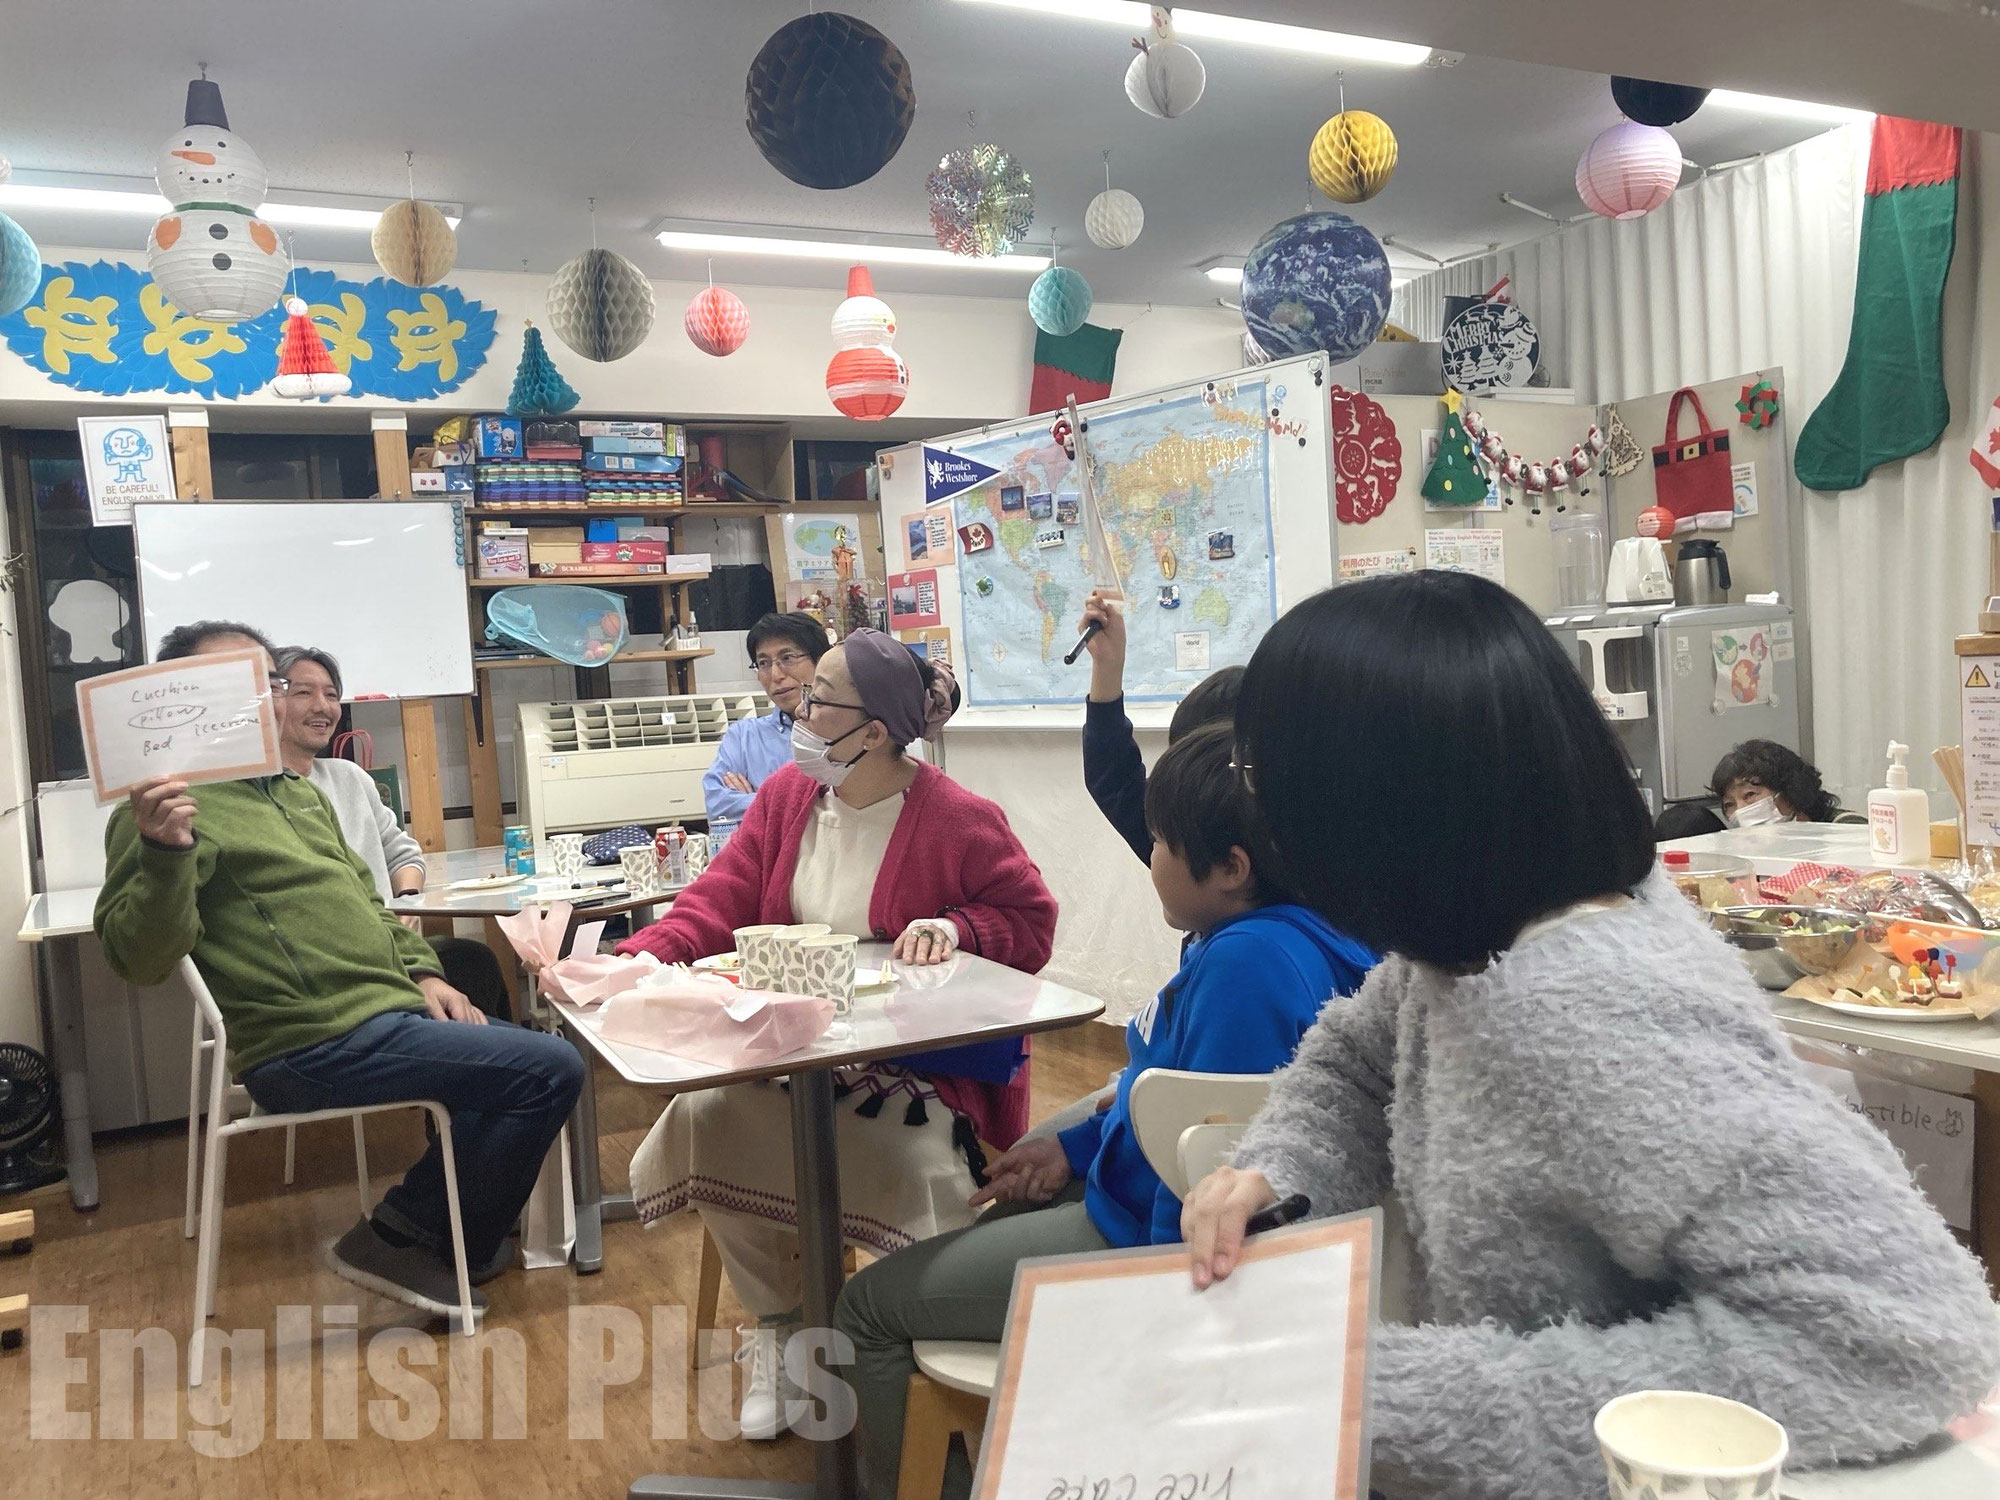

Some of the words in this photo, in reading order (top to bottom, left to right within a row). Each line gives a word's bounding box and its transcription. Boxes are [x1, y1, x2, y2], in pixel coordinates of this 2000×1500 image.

[1450, 321, 1491, 341] MERRY
[1443, 331, 1504, 354] CHRISTMAS
[945, 461, 971, 472] Brookes
[945, 472, 978, 483] Westshore
[106, 485, 117, 494] BE
[119, 484, 159, 494] CAREFUL!
[102, 495, 137, 505] ENGLISH
[143, 735, 173, 757] Bed
